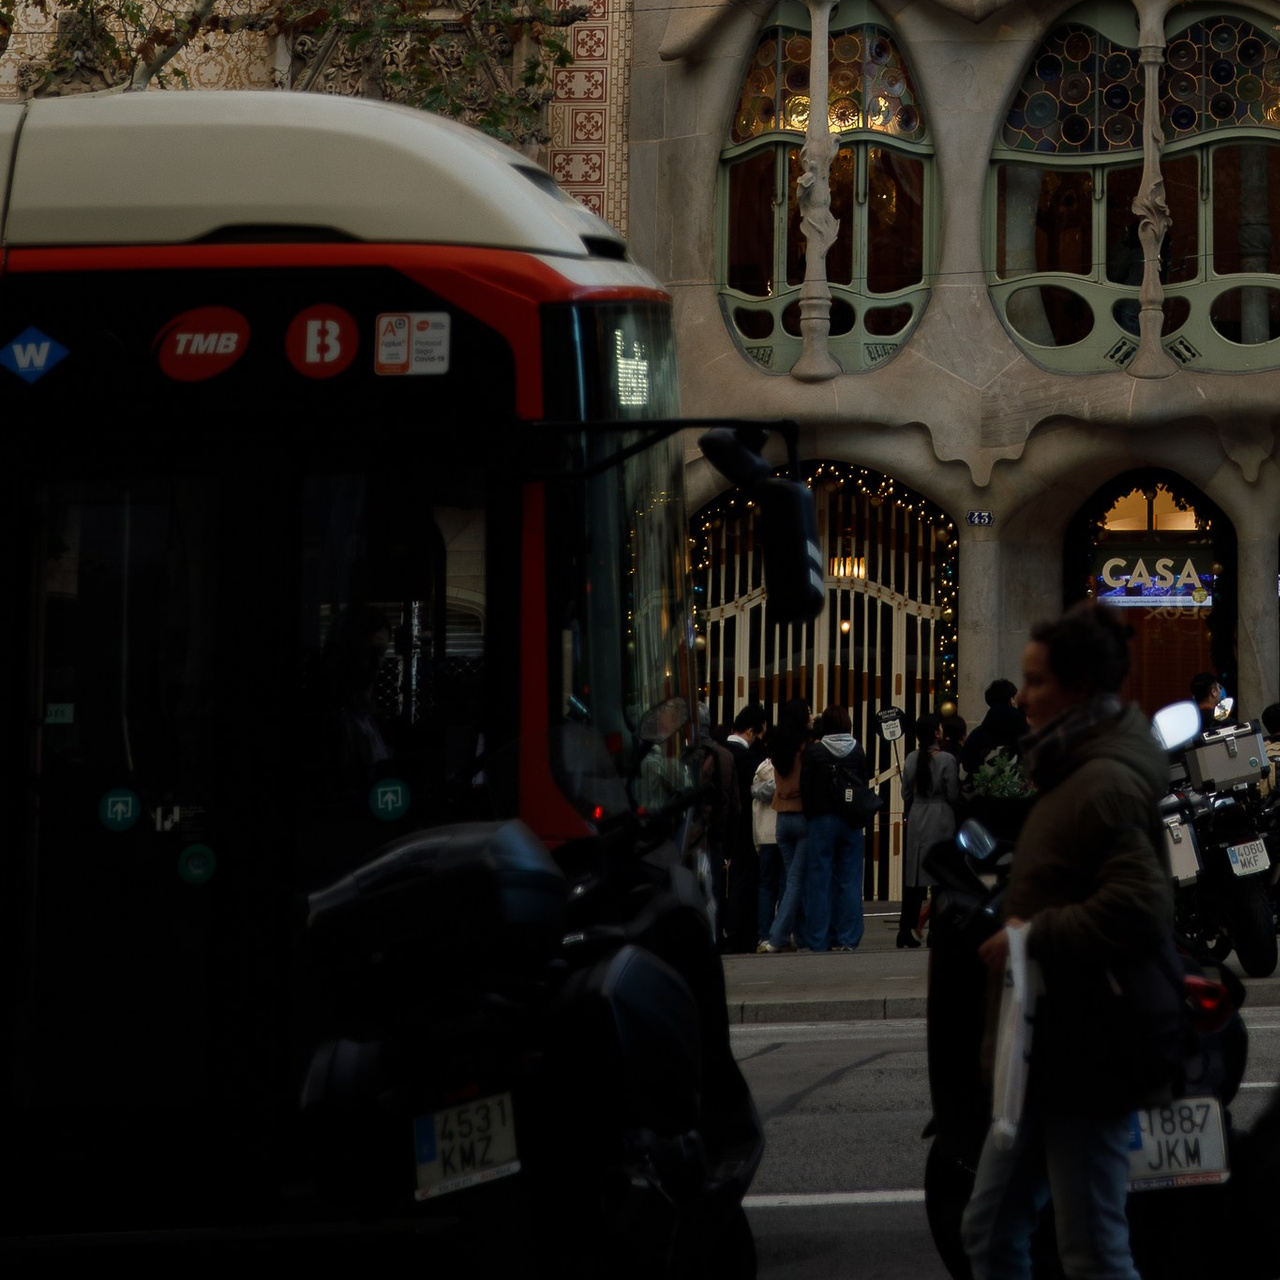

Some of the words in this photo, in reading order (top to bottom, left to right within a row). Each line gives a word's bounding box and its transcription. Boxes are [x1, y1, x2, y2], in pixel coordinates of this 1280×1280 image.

[175, 333, 239, 355] TMB
[971, 512, 989, 524] 43
[1102, 557, 1202, 588] CASA
[1238, 842, 1264, 858] 4060
[1240, 855, 1259, 870] MKF
[441, 1099, 506, 1143] 4531
[441, 1135, 493, 1177] KMZ
[1149, 1137, 1202, 1171] JKM
